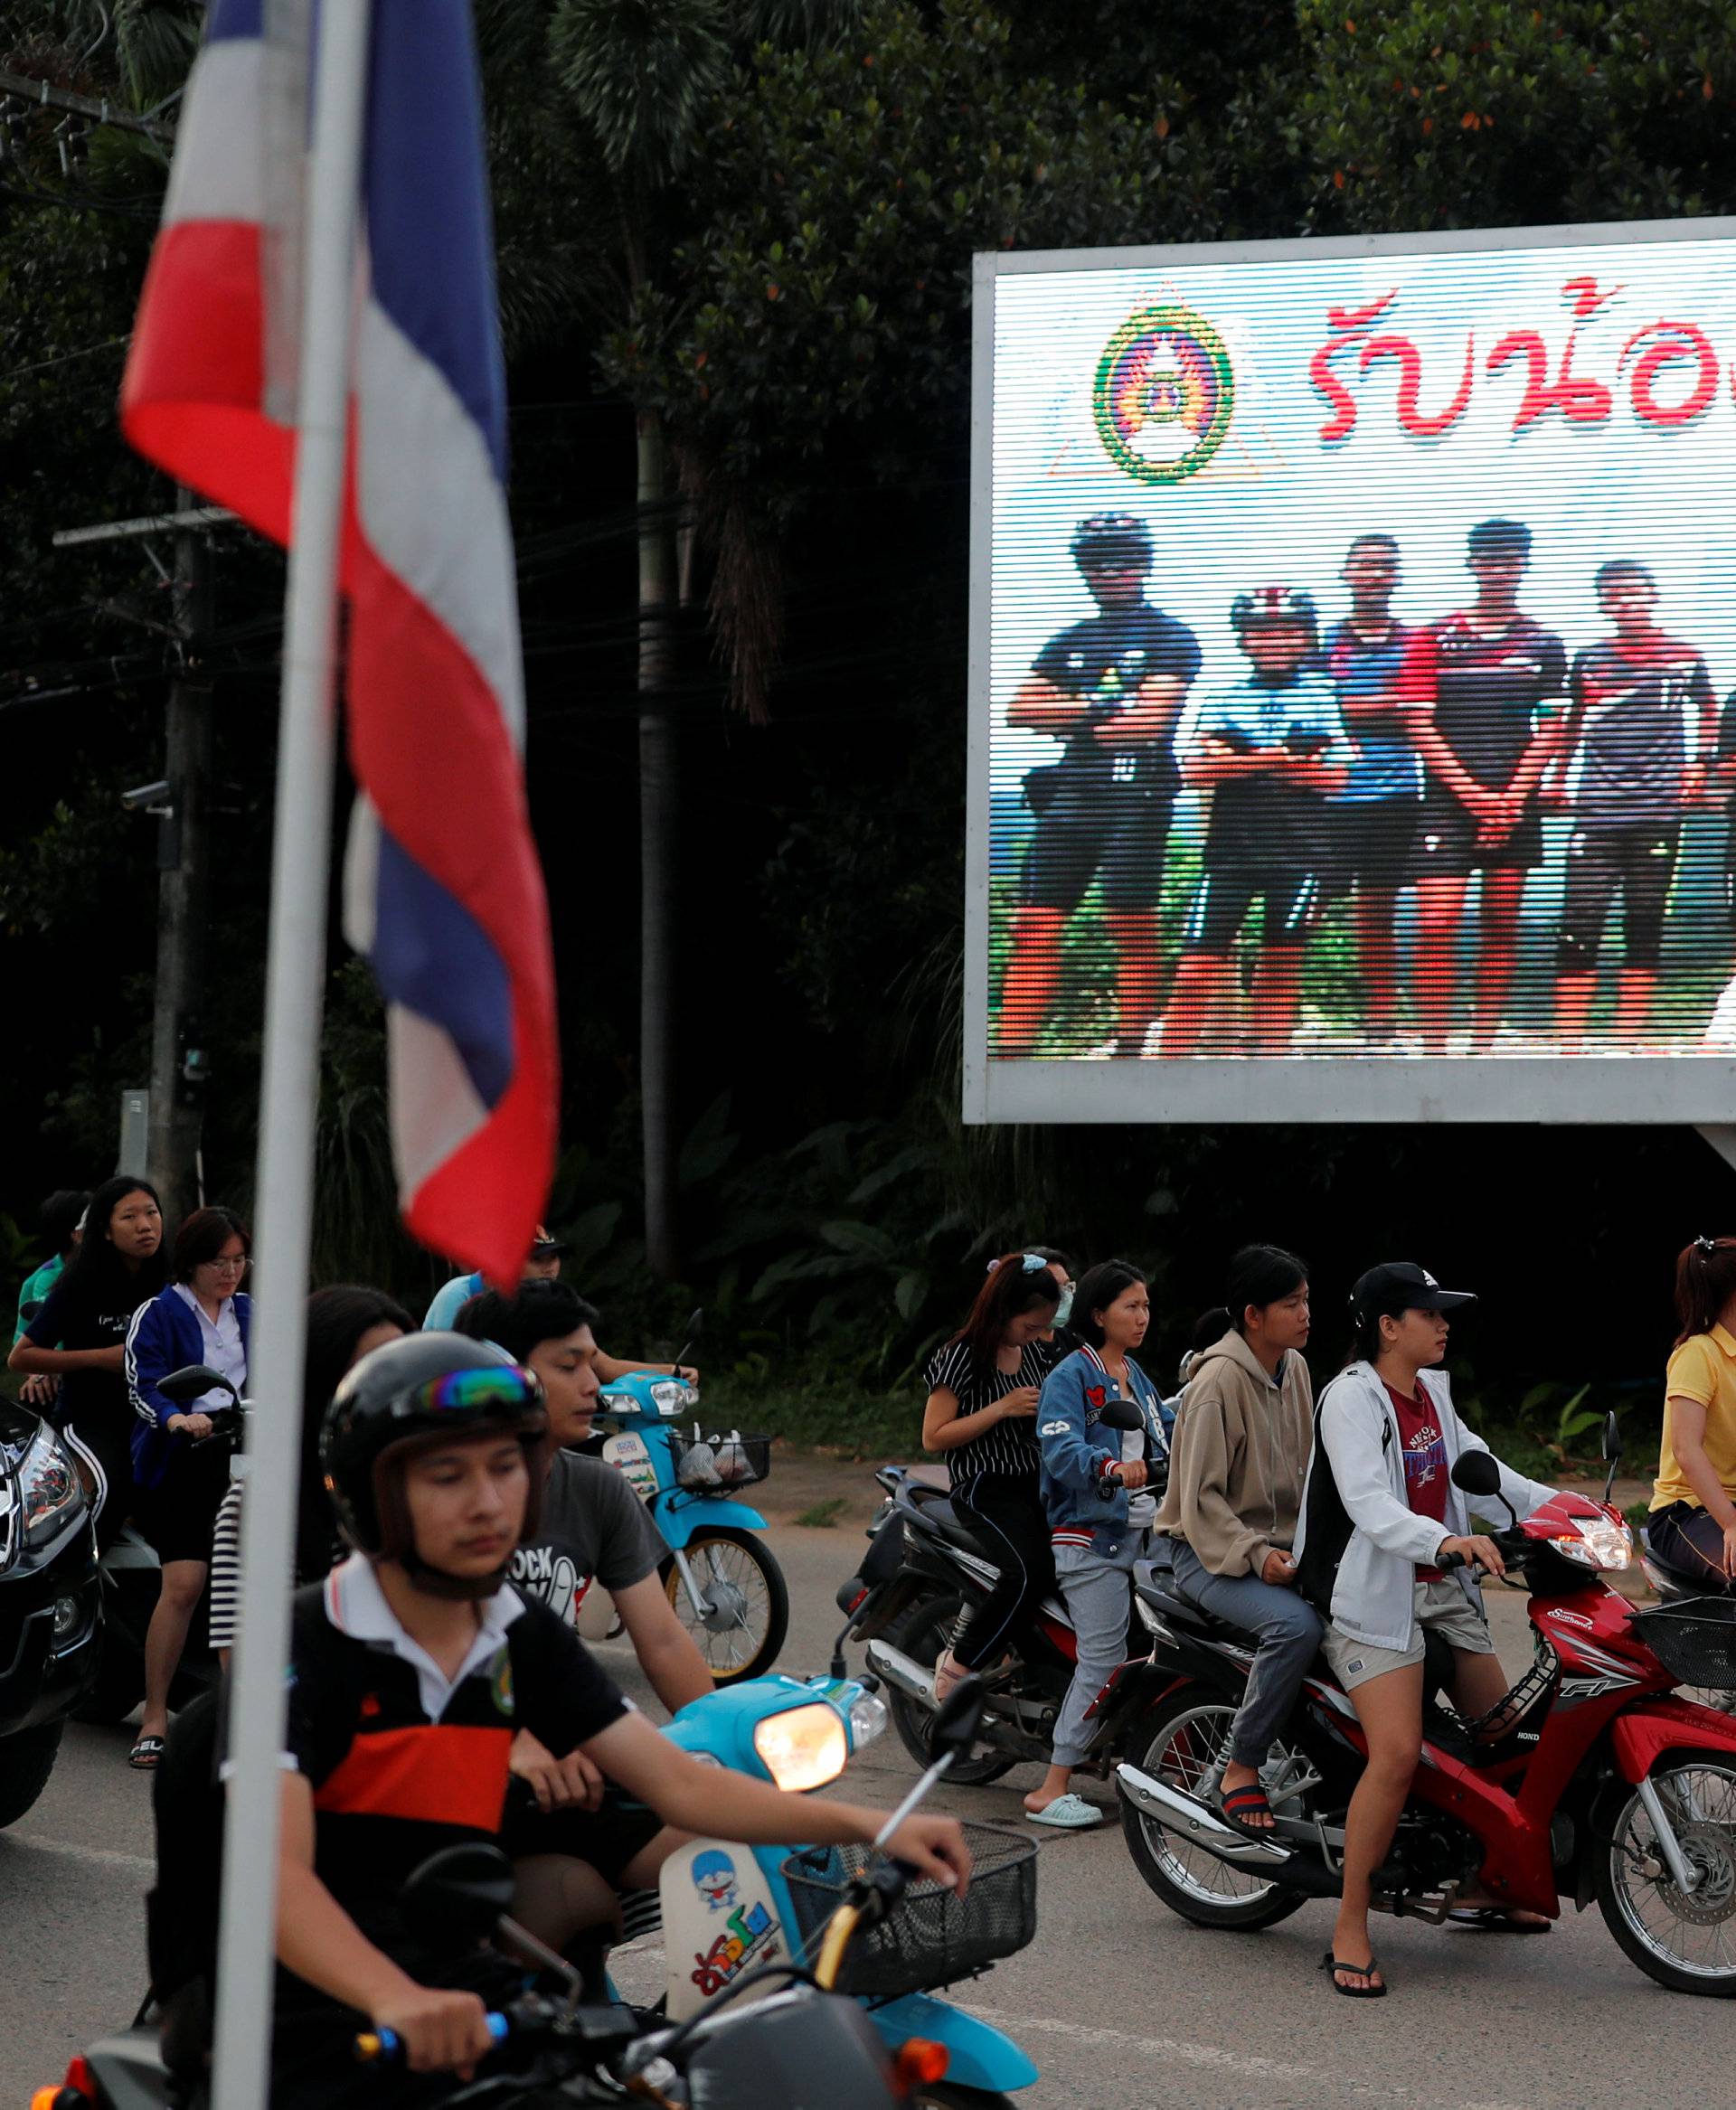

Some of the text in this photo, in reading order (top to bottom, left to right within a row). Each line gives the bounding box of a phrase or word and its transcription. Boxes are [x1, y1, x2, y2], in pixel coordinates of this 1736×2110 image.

[1309, 276, 1736, 440] รับน้อ
[510, 1546, 552, 1581] OCK
[1517, 1731, 1541, 1741] HOND
